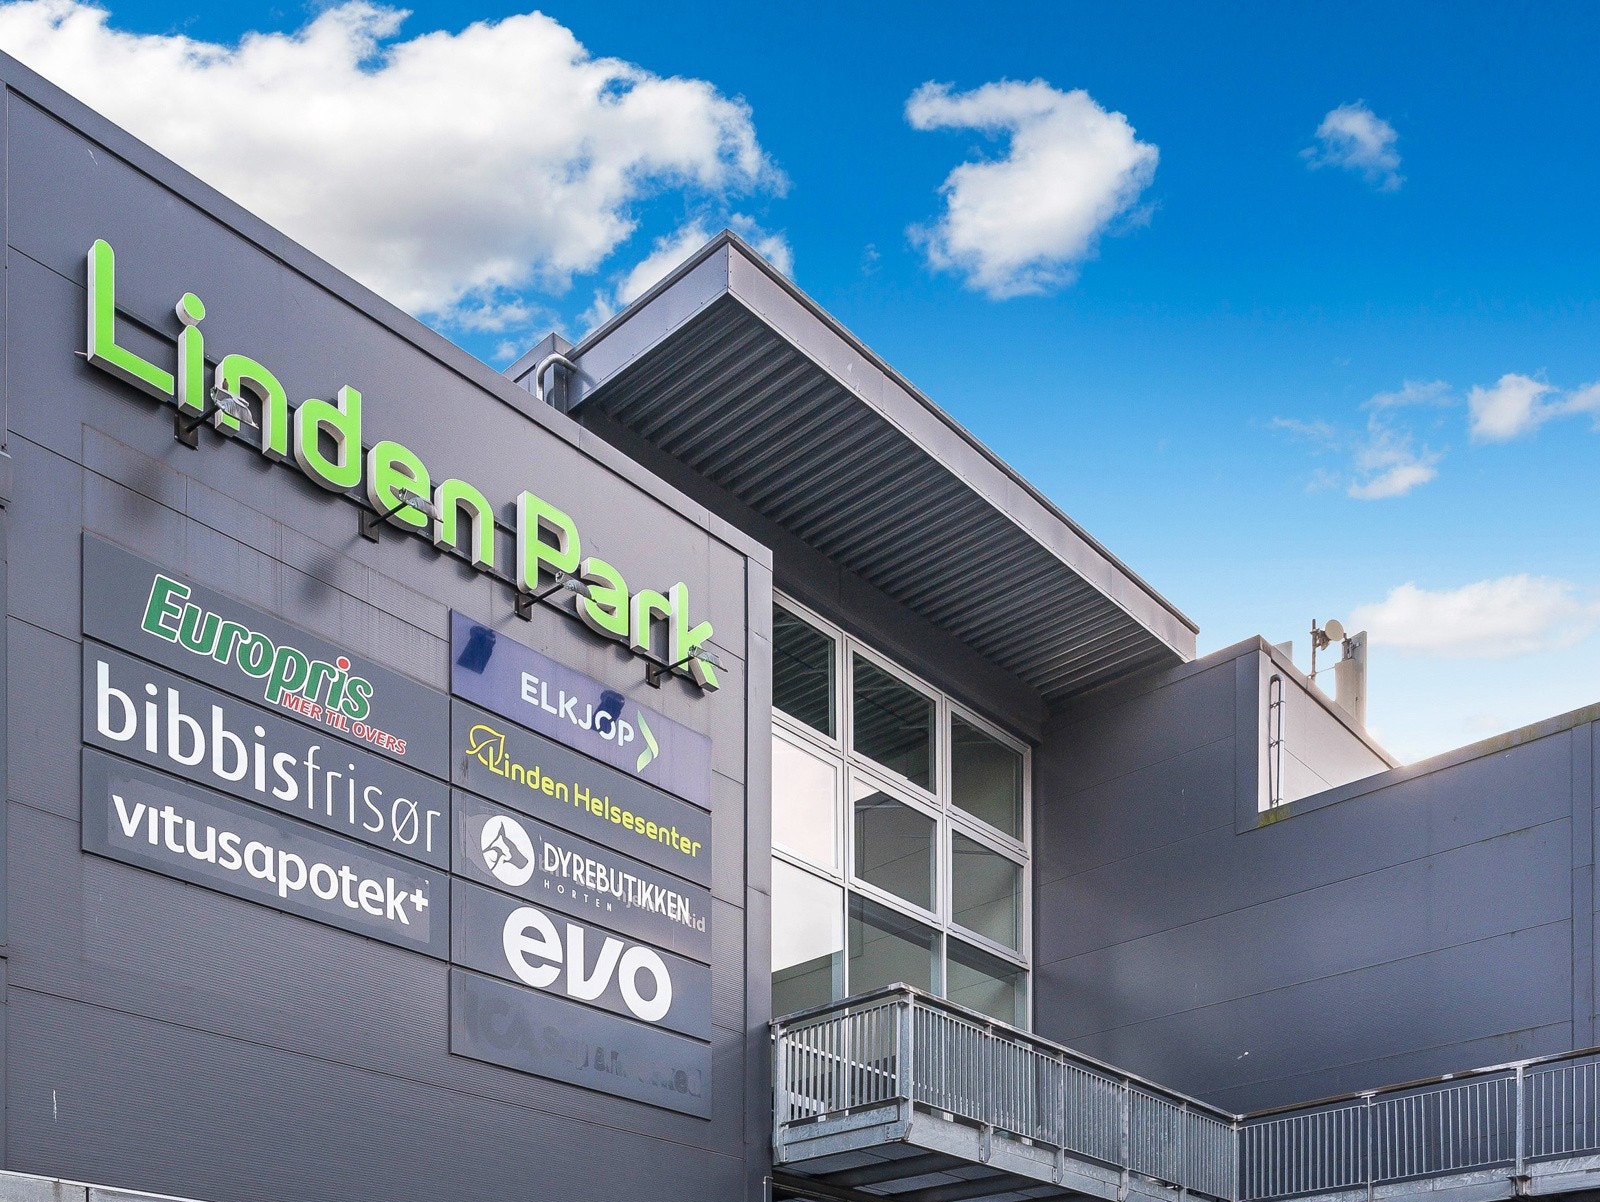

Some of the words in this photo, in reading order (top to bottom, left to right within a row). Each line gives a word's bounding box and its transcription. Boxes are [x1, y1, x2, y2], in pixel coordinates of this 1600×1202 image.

[87, 239, 494, 571] Linden
[516, 490, 721, 692] Park
[141, 573, 374, 721] Europris
[283, 692, 322, 722] MER
[325, 709, 350, 733] TIL
[353, 721, 407, 756] OVERS
[488, 746, 569, 803] Linden
[574, 782, 702, 857] Helsesenter
[544, 842, 690, 926] DYREBUTIKKEN
[544, 879, 612, 912] HORTEN
[502, 907, 673, 1022] evo
